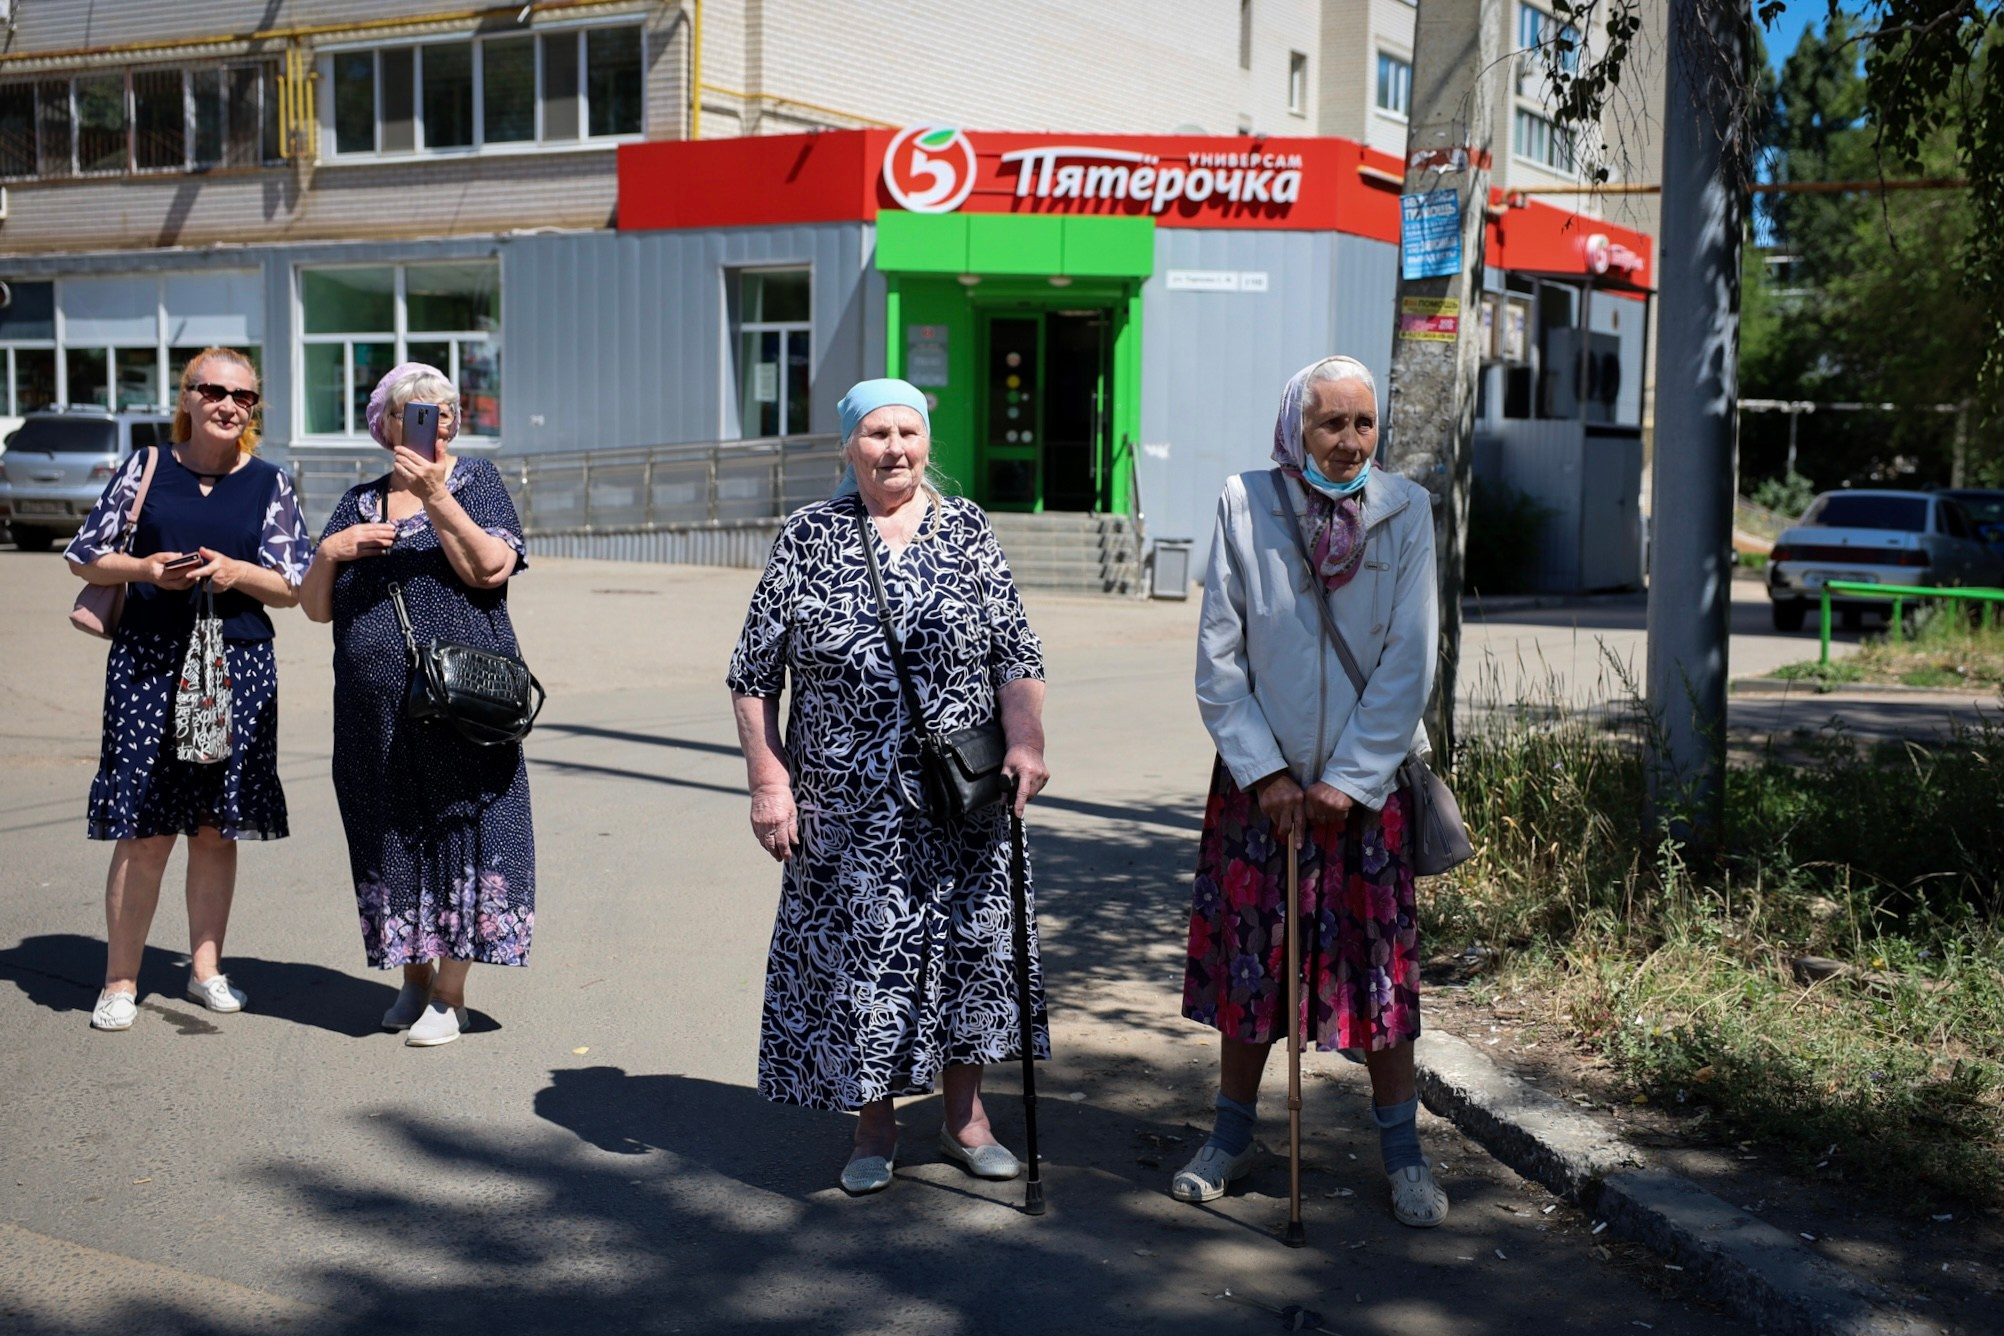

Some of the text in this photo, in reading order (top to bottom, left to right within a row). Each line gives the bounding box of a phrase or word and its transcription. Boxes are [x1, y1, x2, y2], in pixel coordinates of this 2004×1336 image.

[1188, 152, 1303, 169] УНИВЕРСАМ
[1001, 145, 1303, 213] Пятёрочка
[1418, 299, 1458, 309] ПОМОЩЬ
